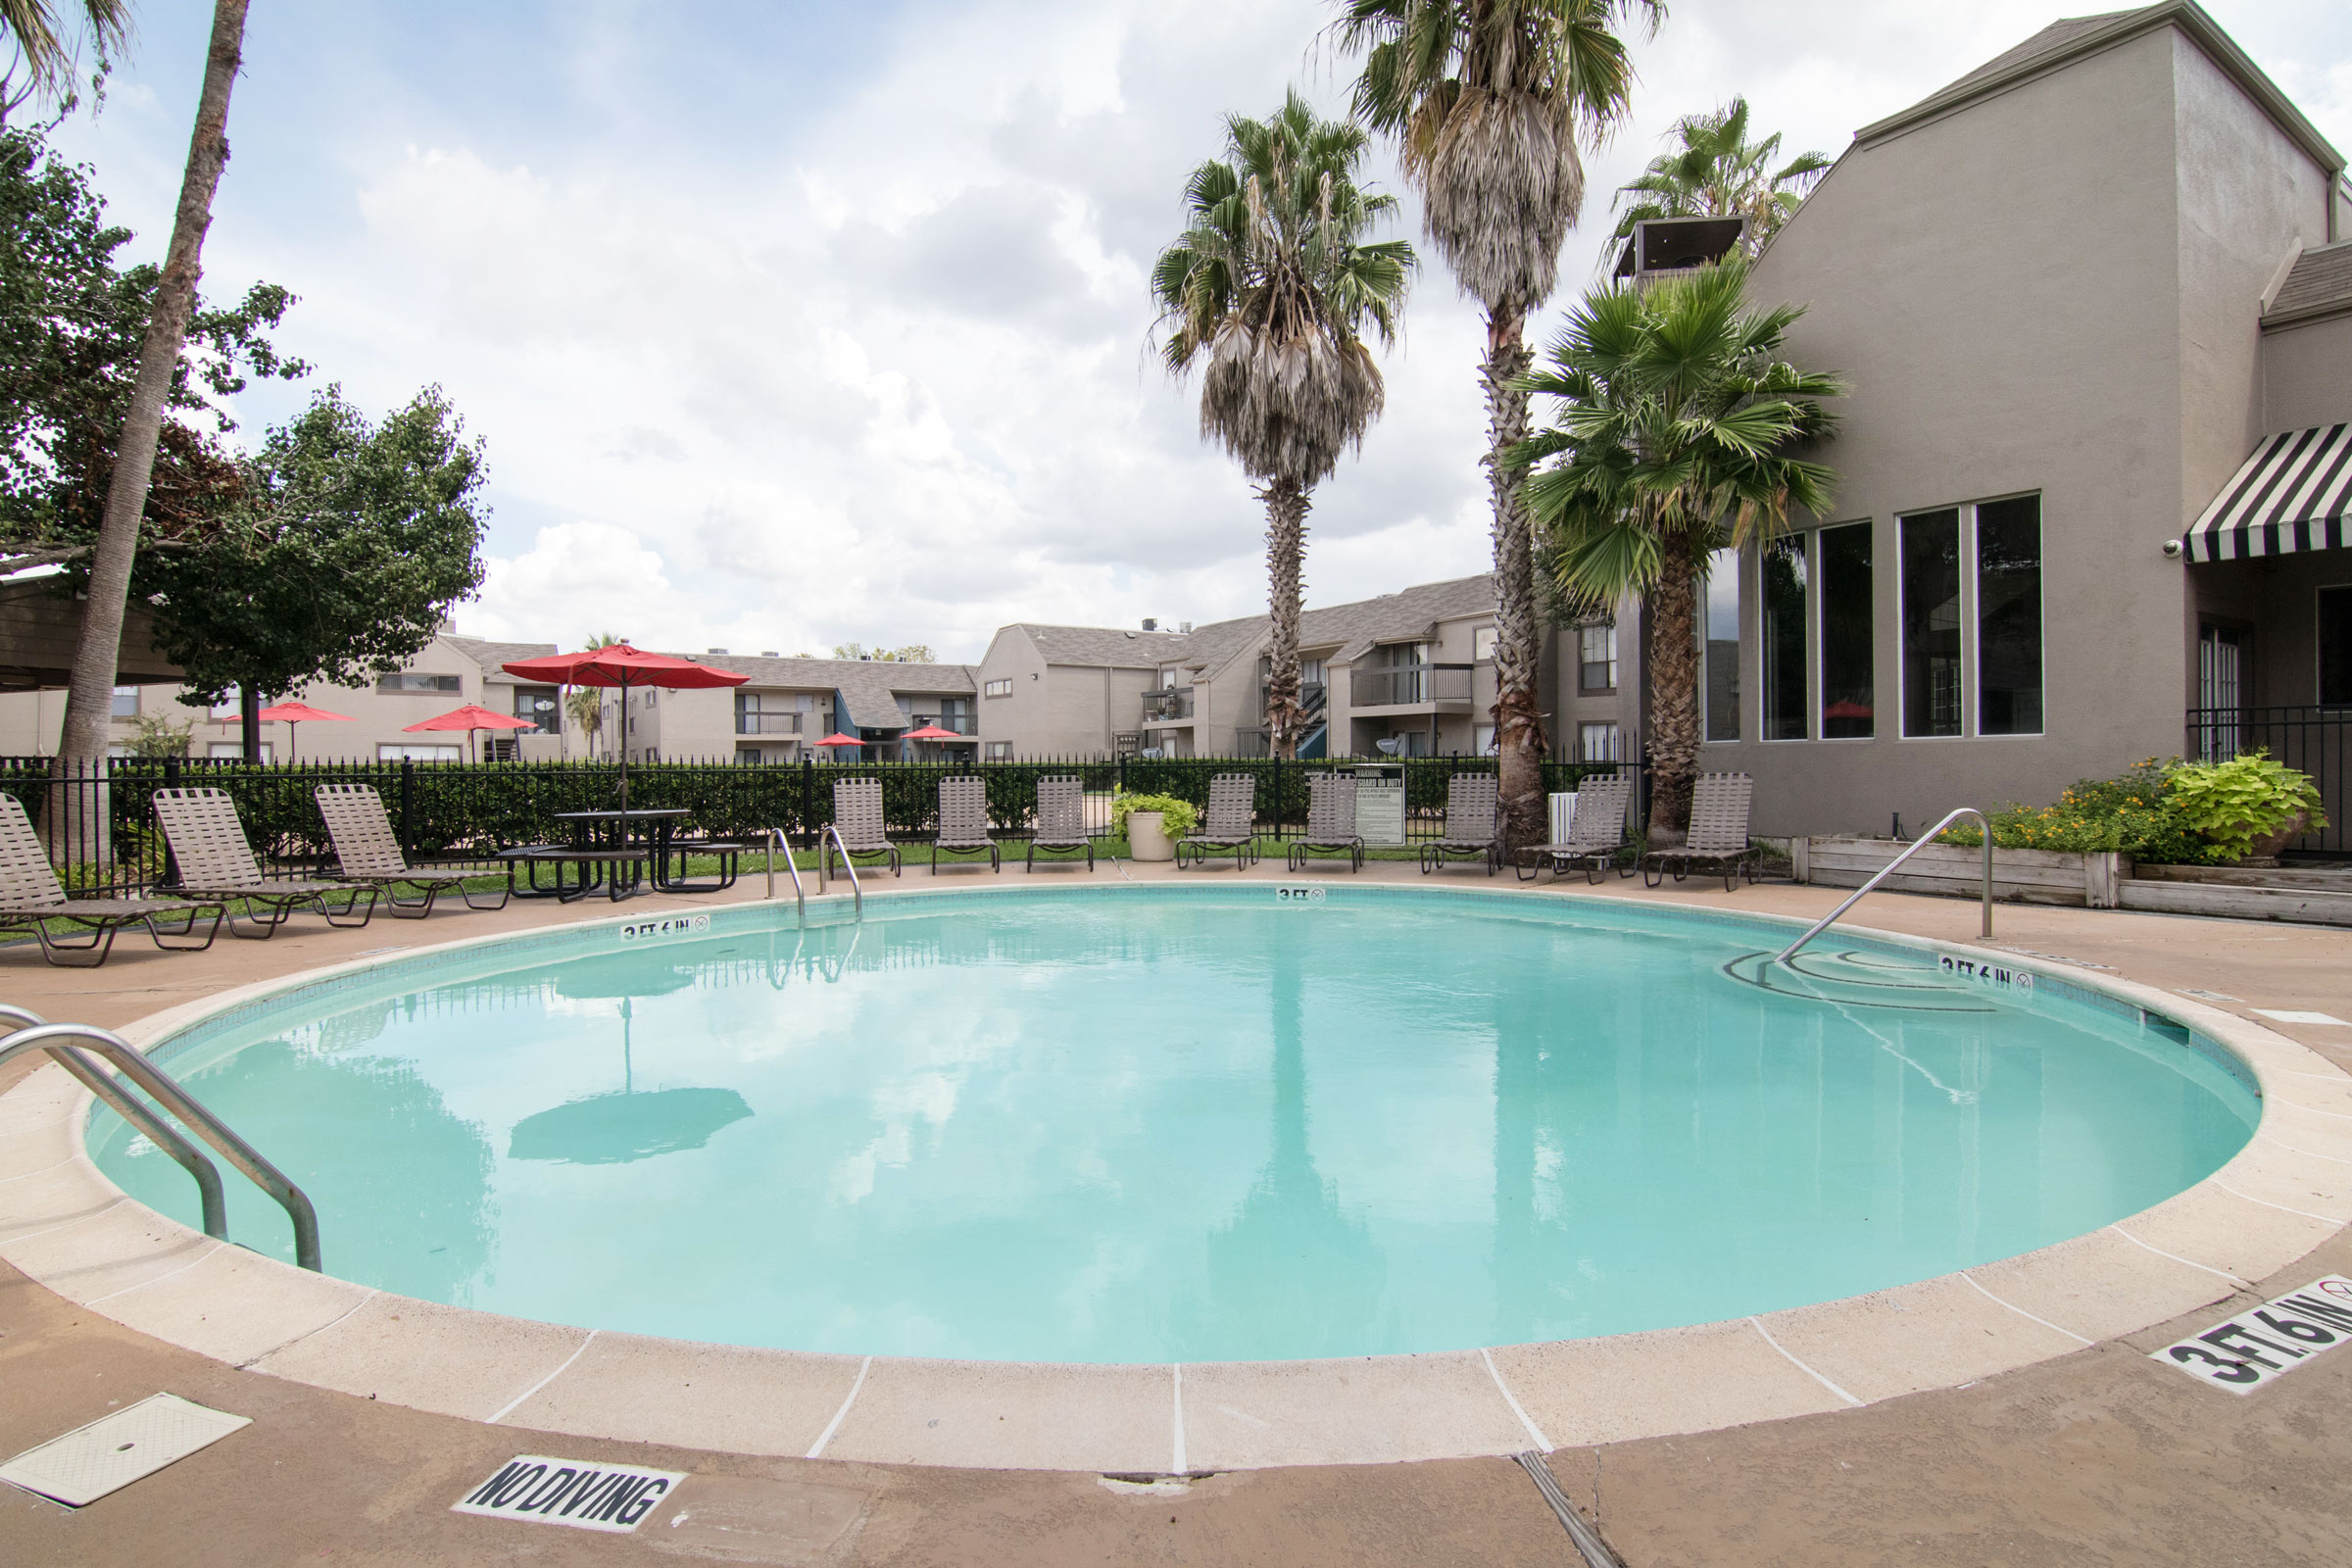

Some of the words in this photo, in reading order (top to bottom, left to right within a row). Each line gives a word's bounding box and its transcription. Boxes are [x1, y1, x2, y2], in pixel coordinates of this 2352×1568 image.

[1355, 768, 1384, 778] WARNING:
[1377, 778, 1387, 787] ON
[1387, 778, 1401, 787] DUTY
[1279, 889, 1290, 900] 3
[624, 926, 636, 939] 3
[675, 919, 690, 933] IN
[1941, 956, 1954, 973] 3
[1995, 968, 2011, 989] IN
[2253, 1309, 2336, 1344] 6
[2274, 1294, 2352, 1333] IN
[2169, 1346, 2260, 1384] 3
[466, 1461, 548, 1508] NO
[515, 1467, 669, 1526] DIVING
